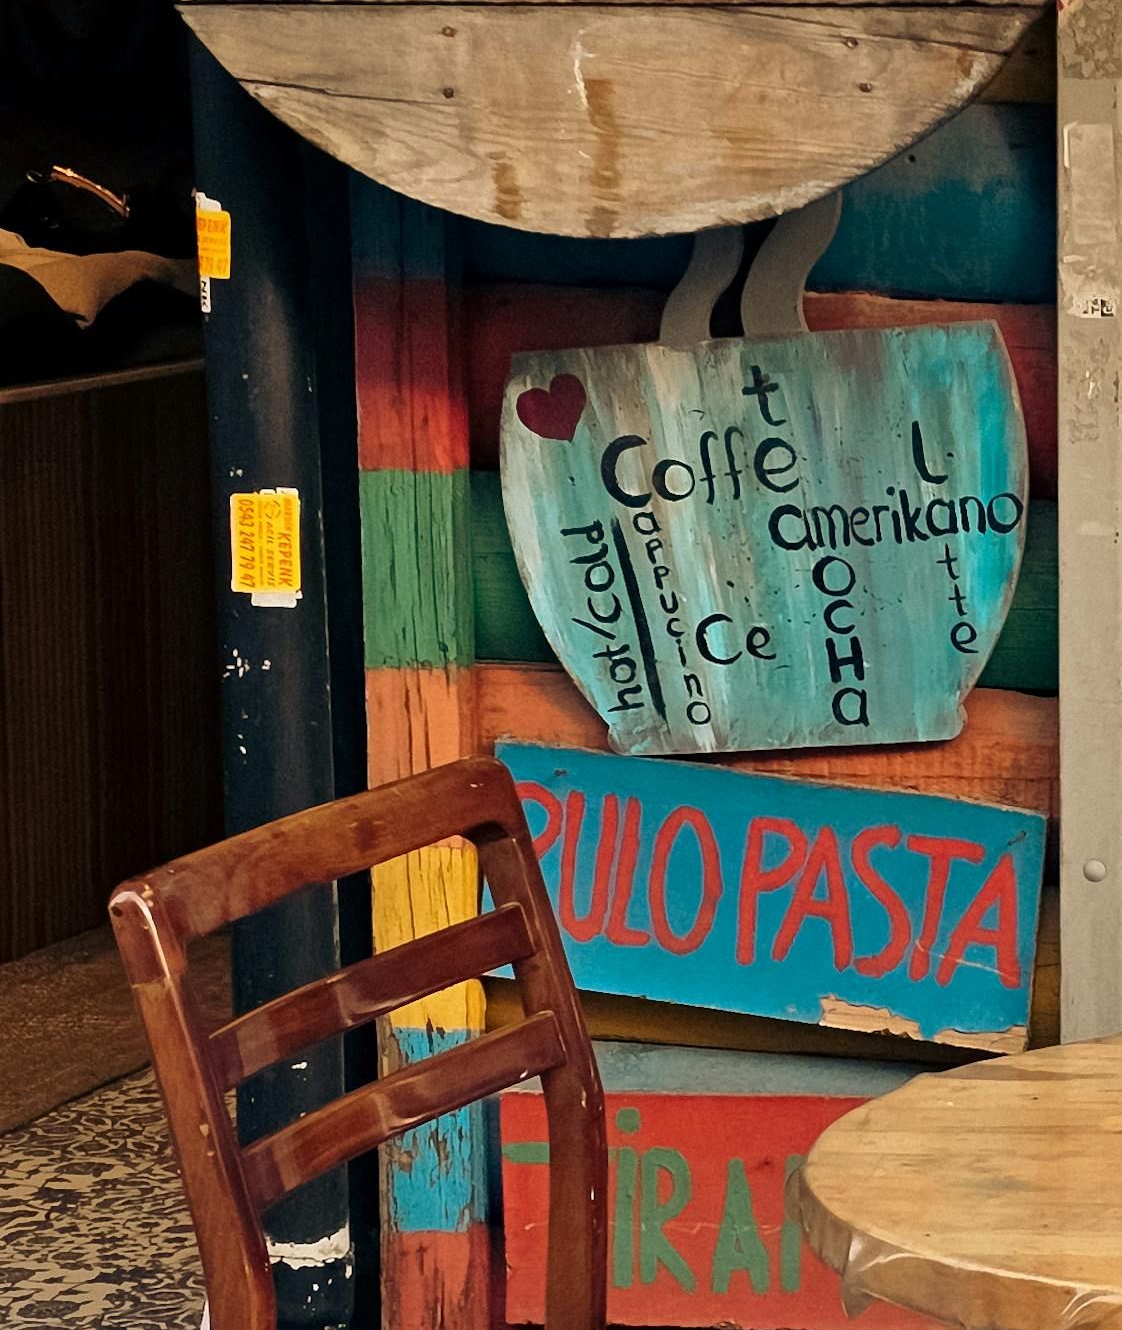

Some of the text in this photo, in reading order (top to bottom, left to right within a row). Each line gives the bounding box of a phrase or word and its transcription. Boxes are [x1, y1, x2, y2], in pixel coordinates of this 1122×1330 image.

[601, 426, 801, 508] Coffe
[768, 486, 1023, 551] amerikano
[735, 816, 1023, 989] PASTA
